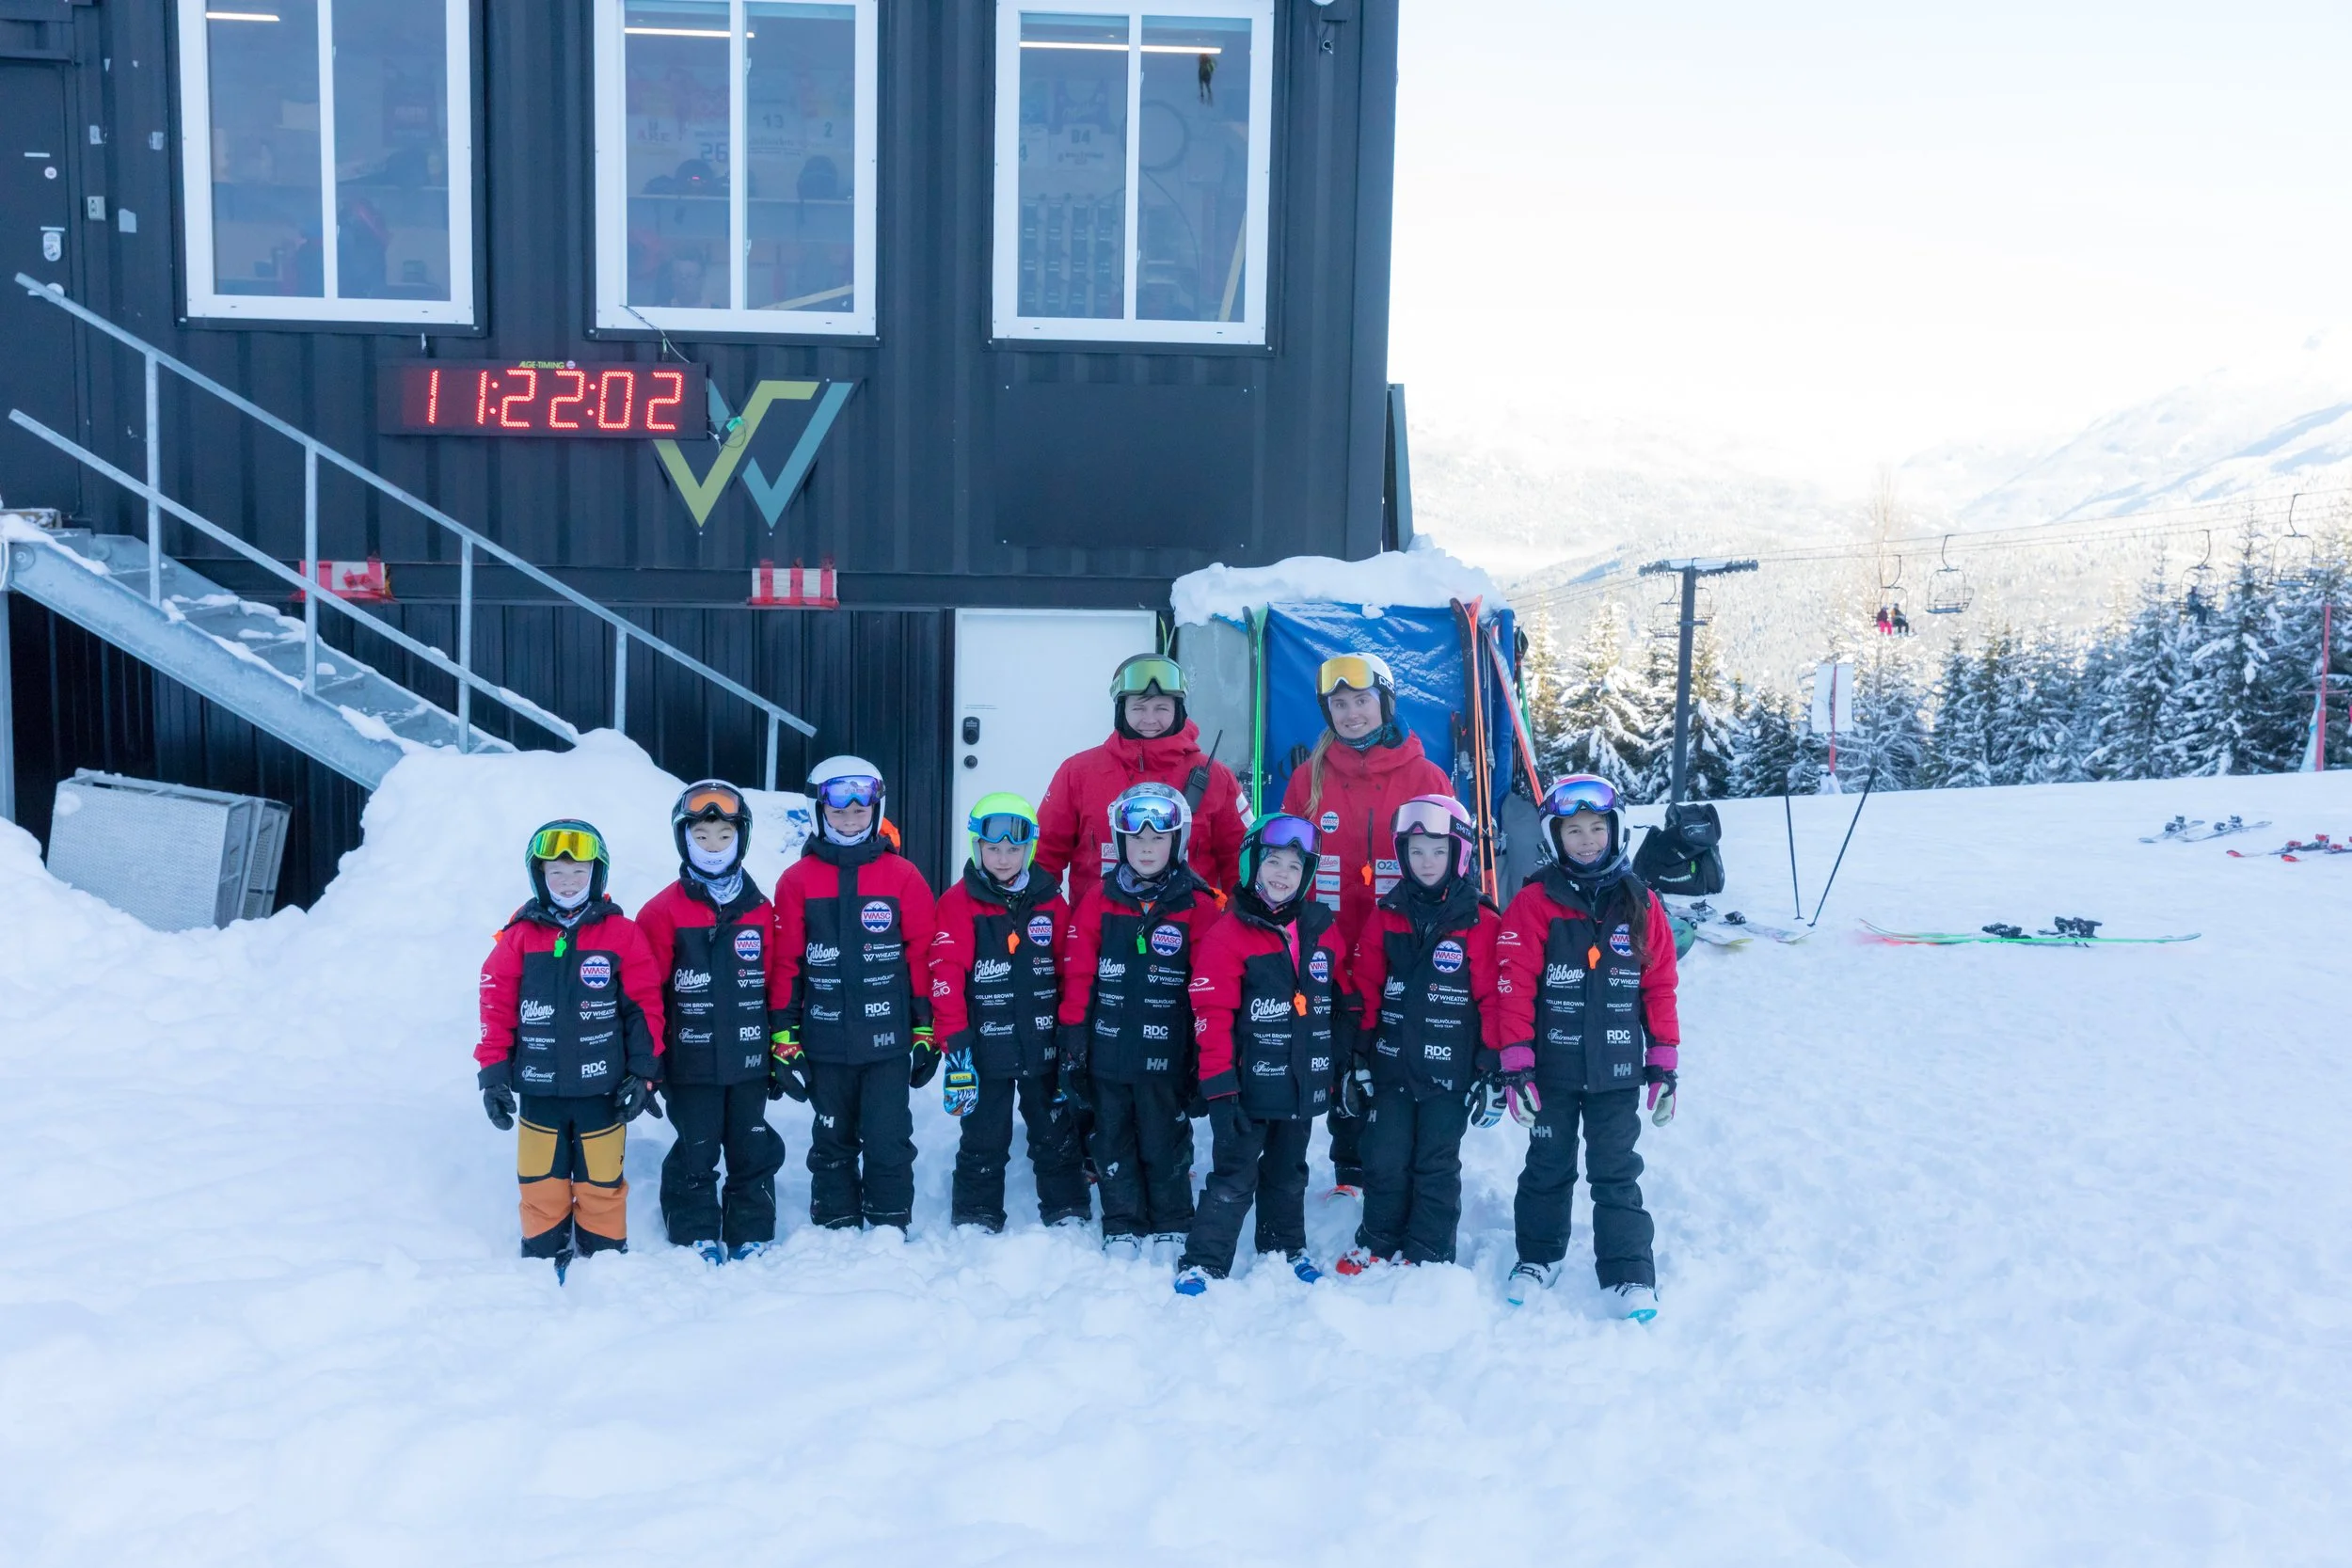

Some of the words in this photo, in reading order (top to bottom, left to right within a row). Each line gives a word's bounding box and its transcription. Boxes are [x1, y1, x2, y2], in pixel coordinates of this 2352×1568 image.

[1455, 823, 1471, 837] SMITH
[1153, 934, 1181, 944] WMSC
[806, 942, 840, 965] Gibbons
[875, 950, 900, 958] WHEATON
[1435, 951, 1462, 960] WMSC
[975, 958, 1011, 982] Gibbons
[1547, 963, 1585, 986] Gibbons
[675, 968, 711, 991] Gibbons
[1439, 994, 1468, 1003] WHEATON
[520, 1000, 555, 1023] Gibbons
[865, 1001, 890, 1014] RDC
[1250, 998, 1292, 1022] Gibbons
[1035, 1015, 1054, 1026] RDC
[678, 1027, 712, 1040] Fairmont
[739, 1025, 761, 1037] RDC
[980, 1022, 1015, 1034] Fairmont
[1143, 1024, 1168, 1036] RDC
[1548, 1028, 1582, 1041] Fairmont
[873, 1032, 895, 1048] HH
[1606, 1030, 1630, 1040] RDC
[1044, 1047, 1057, 1061] HH
[1424, 1044, 1452, 1057] RDC
[581, 1060, 607, 1075] RDC
[745, 1053, 762, 1069] HH
[1146, 1057, 1168, 1070] HH
[1252, 1060, 1288, 1073] Fairmont
[1311, 1056, 1329, 1068] RDC
[521, 1065, 556, 1079] Fairmont
[1613, 1062, 1631, 1077] HH
[1532, 1125, 1552, 1138] HH
